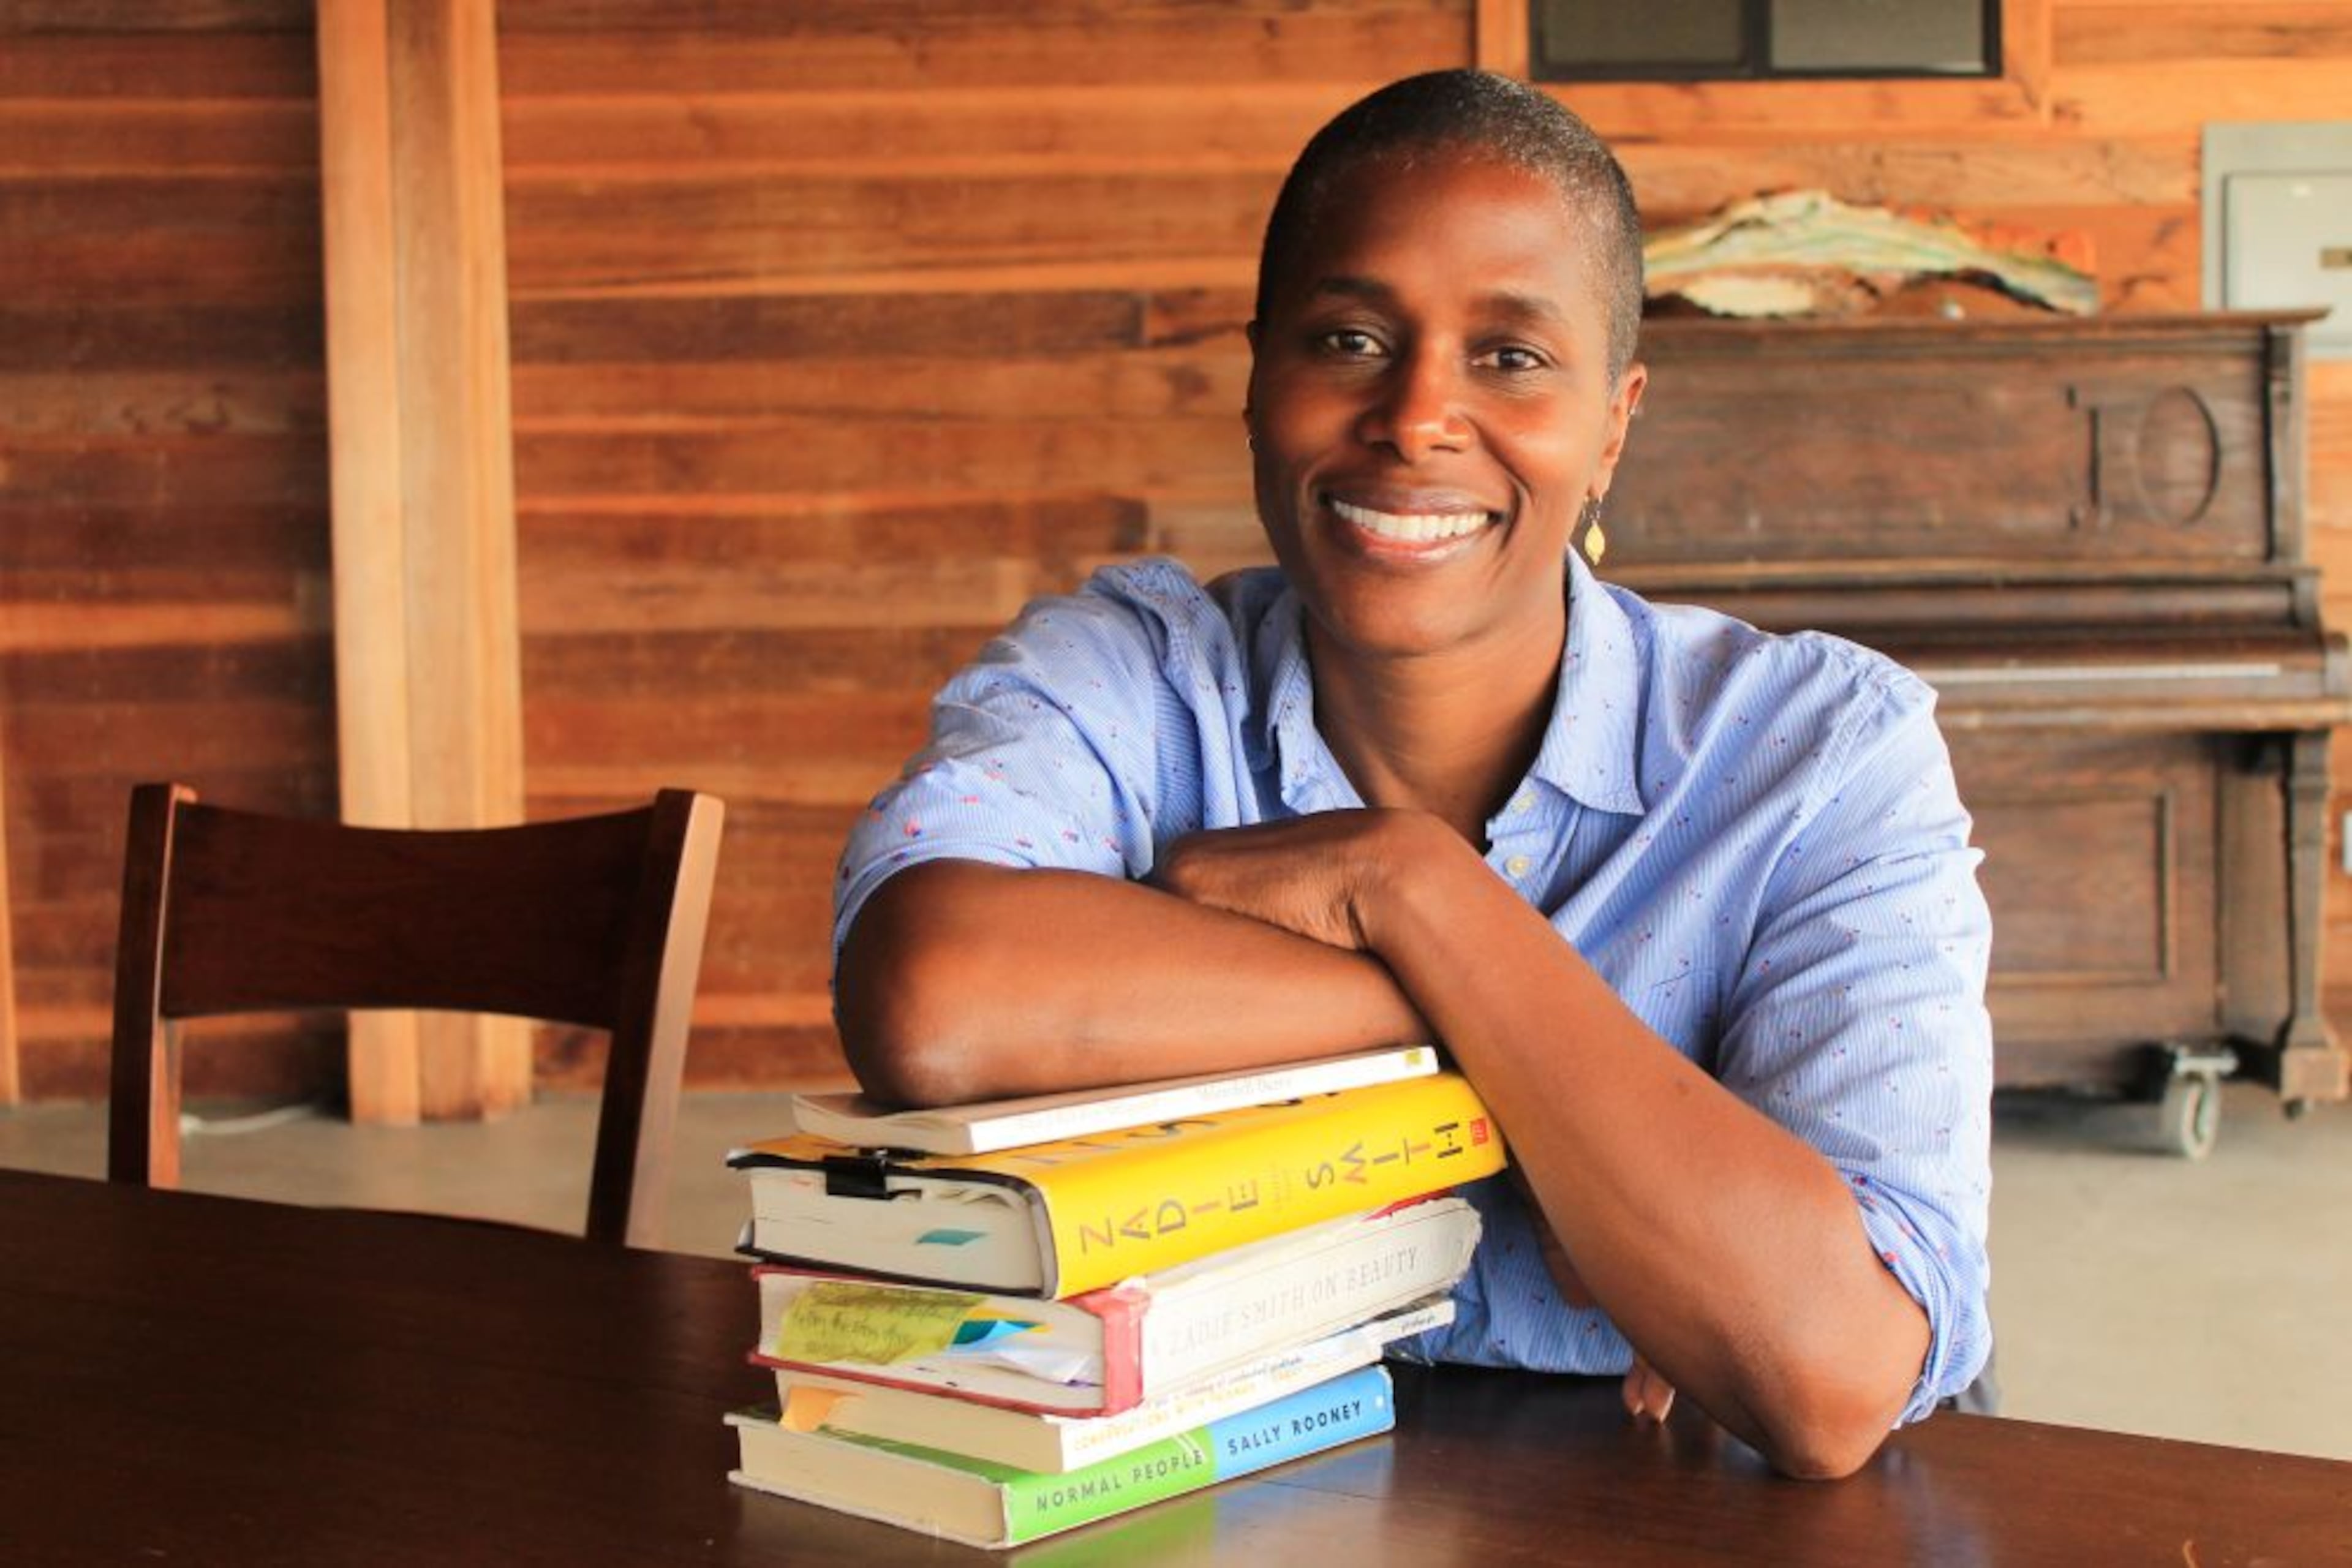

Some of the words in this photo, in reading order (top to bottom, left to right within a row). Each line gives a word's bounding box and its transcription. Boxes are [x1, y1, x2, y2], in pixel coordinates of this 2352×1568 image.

[1080, 1178, 1259, 1254] ZADIE
[1306, 1122, 1463, 1189] SMITH
[1169, 1319, 1237, 1356] ZADIE
[1240, 1283, 1305, 1329] SMITH
[1313, 1281, 1338, 1306] ON
[1347, 1246, 1419, 1294] BEAUTY
[1036, 1472, 1123, 1513] NORMAL
[1131, 1447, 1204, 1483] PEOPLE
[1227, 1427, 1281, 1456] SALLY
[1291, 1400, 1363, 1436] ROONEY
